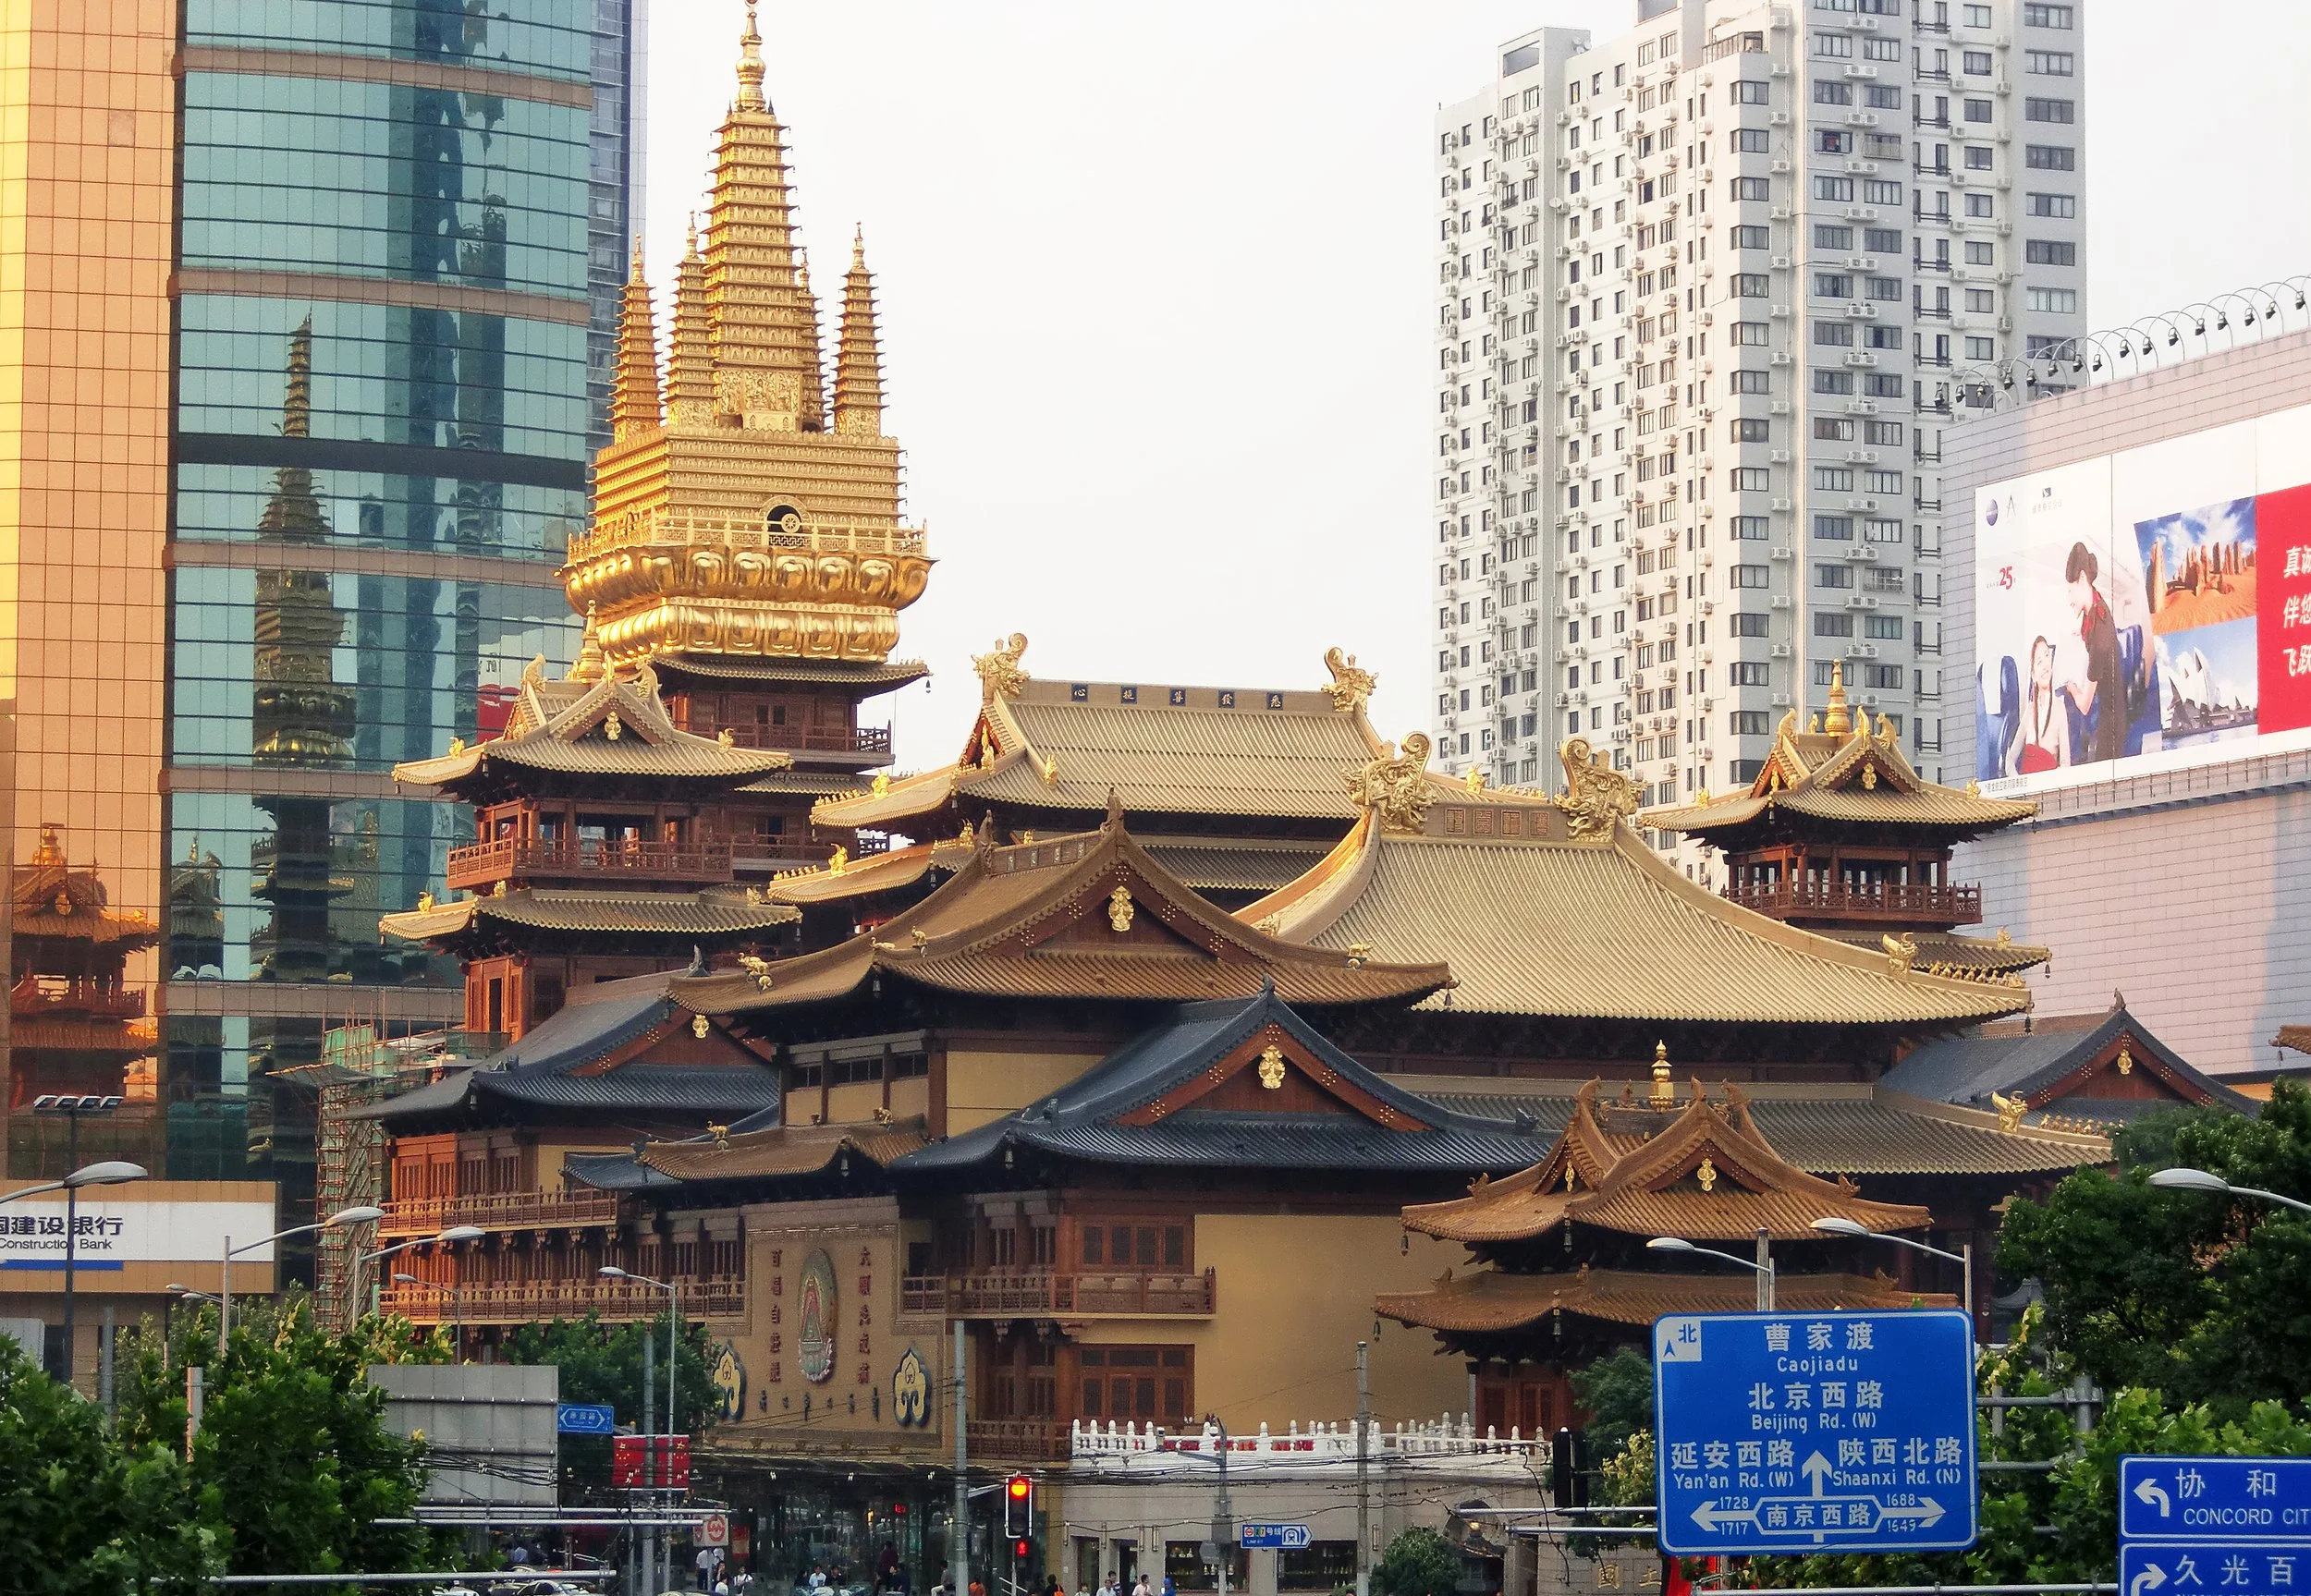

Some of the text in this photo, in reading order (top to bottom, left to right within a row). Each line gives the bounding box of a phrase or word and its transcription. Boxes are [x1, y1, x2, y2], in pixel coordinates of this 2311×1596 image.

[1999, 566, 2013, 590] 25
[80, 1238, 112, 1249] Bank
[1678, 1324, 1697, 1344] 北
[1764, 1322, 1875, 1351] 曹家渡
[1777, 1356, 1858, 1376] Caojiadu
[1748, 1381, 1884, 1410] 北京西路
[1752, 1412, 1877, 1433] Beijing Rd. (W)
[1670, 1439, 1795, 1470] 延安西路
[1838, 1437, 1963, 1468] 陕西北路
[1740, 1473, 1764, 1488] Rd.
[1768, 1471, 1794, 1488] (W)
[1833, 1469, 1961, 1486] Shaanxi Rd. (N)
[1719, 1496, 1749, 1510] 1728
[1886, 1493, 1915, 1507] 1688
[1767, 1503, 1871, 1527] 南京西路
[2183, 1508, 2311, 1525] CONCORD CIT
[1721, 1522, 1748, 1535] 1717
[2173, 1554, 2296, 1586] 久光百
